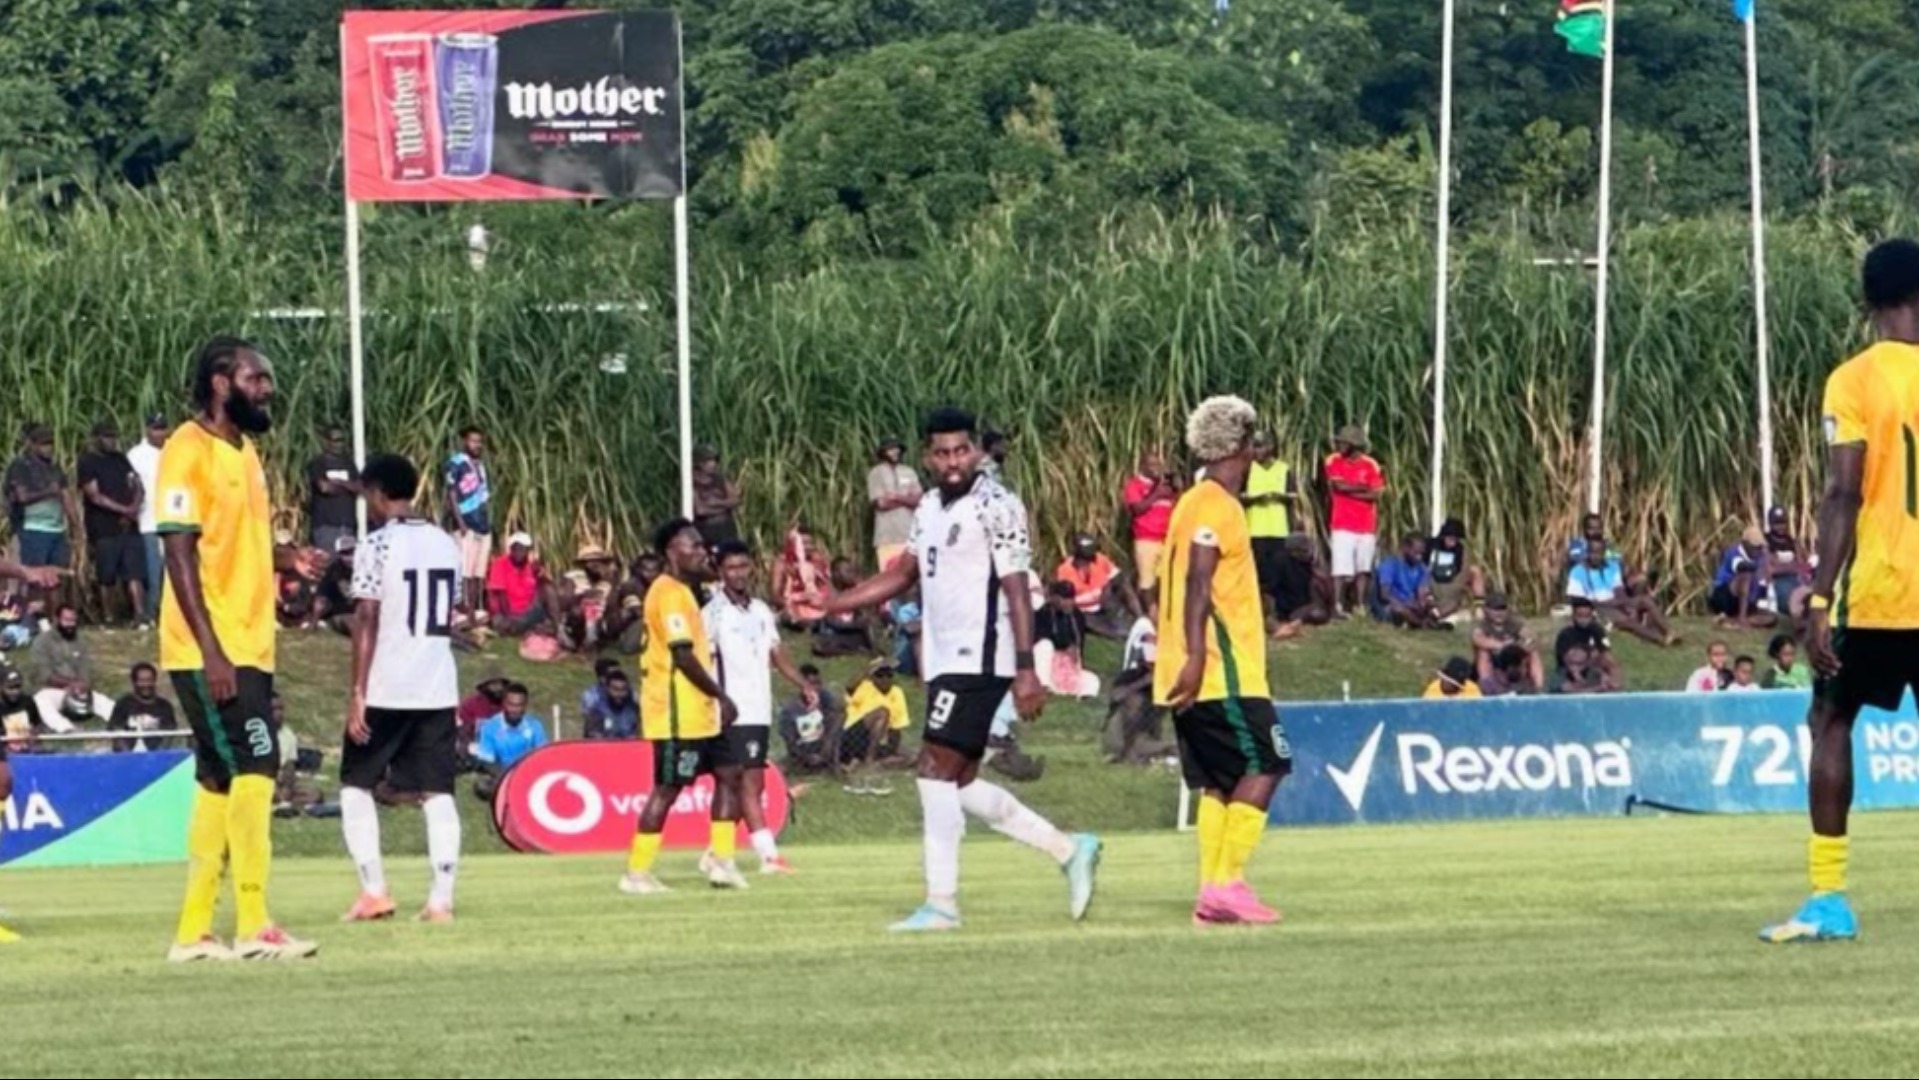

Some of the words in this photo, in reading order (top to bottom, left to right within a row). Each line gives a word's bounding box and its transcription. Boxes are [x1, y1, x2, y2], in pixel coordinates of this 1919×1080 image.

[503, 75, 665, 119] Mother
[927, 546, 937, 577] 9
[402, 568, 456, 636] 10
[928, 689, 957, 730] 9
[245, 717, 272, 757] 3
[1865, 721, 1919, 751] NO
[1397, 732, 1632, 794] Rexona
[1869, 753, 1919, 784] PR
